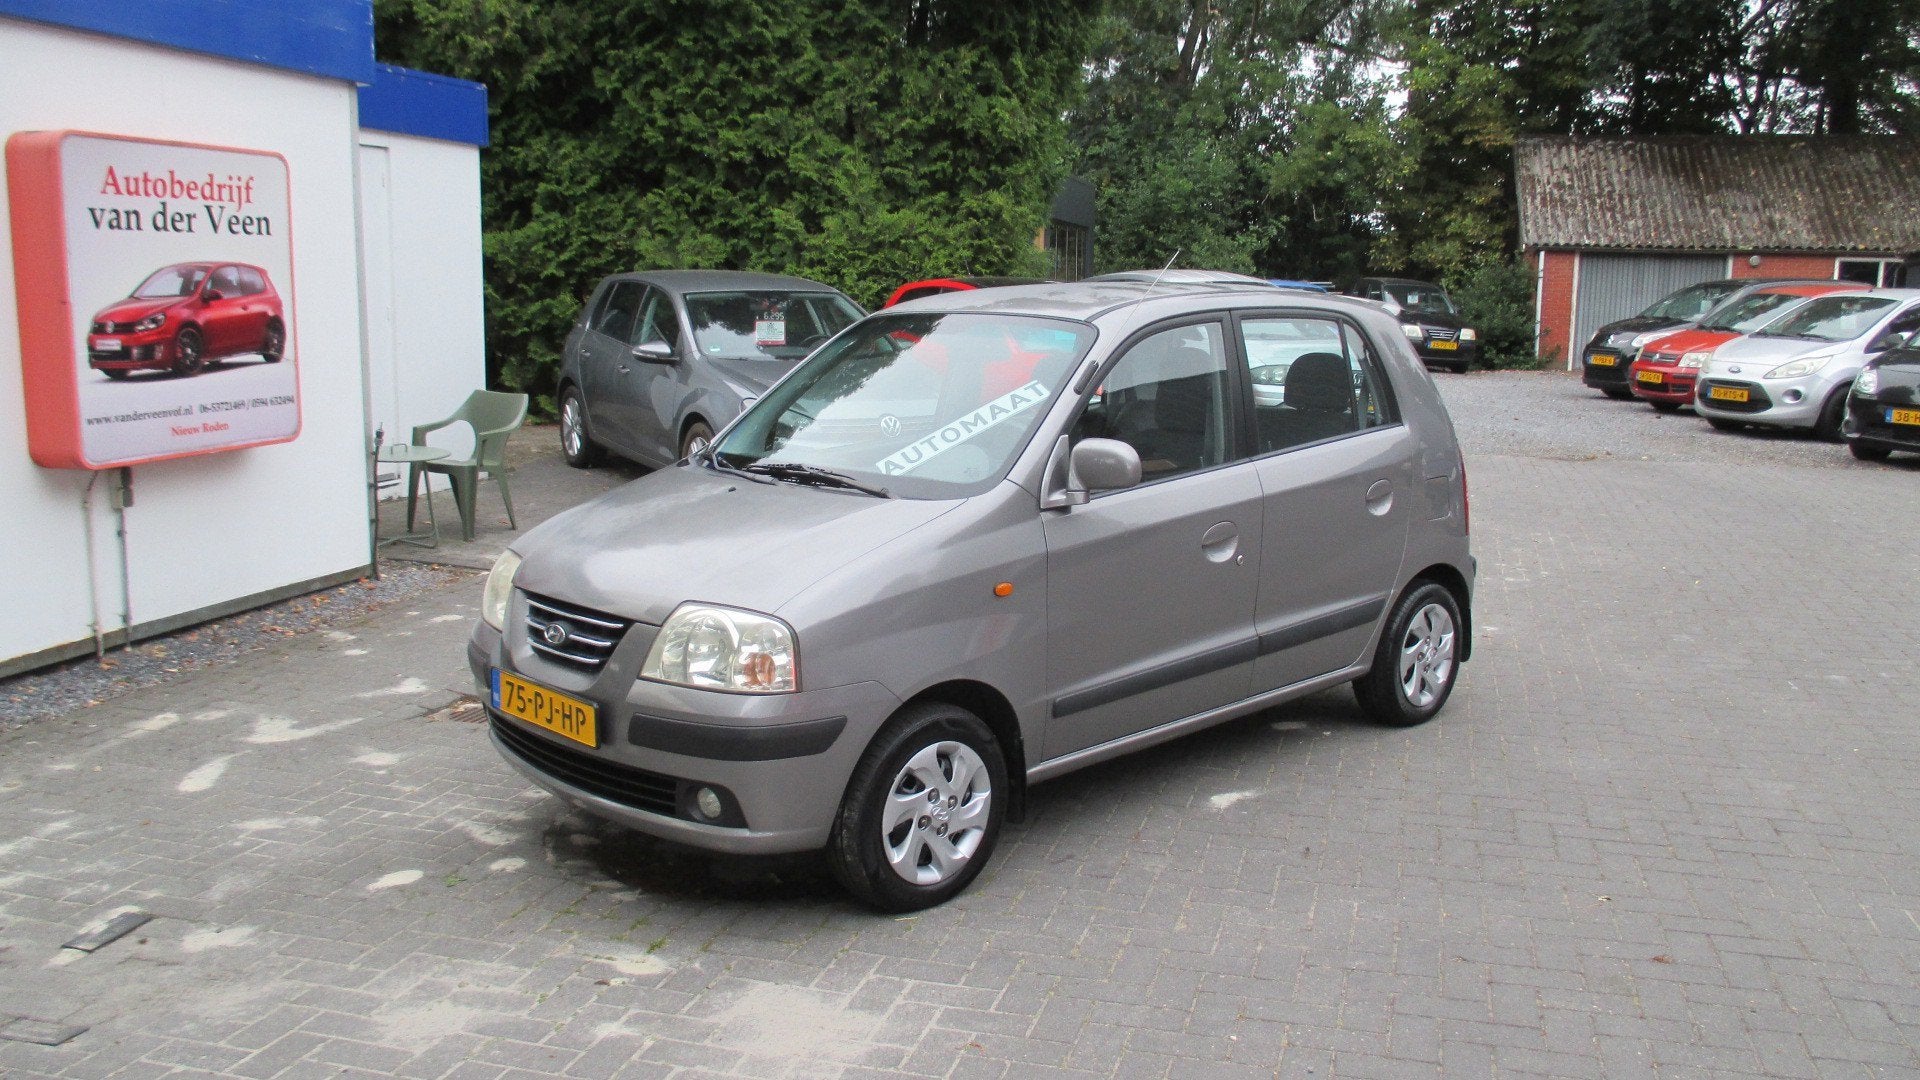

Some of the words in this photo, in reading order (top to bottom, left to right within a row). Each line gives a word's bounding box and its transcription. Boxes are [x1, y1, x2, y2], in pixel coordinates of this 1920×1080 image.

[101, 165, 254, 212] Autobedrijf
[87, 206, 143, 231] van
[152, 201, 197, 232] der
[204, 204, 271, 236] Veen
[171, 425, 200, 436] Nieuw
[203, 421, 229, 432] Roden
[883, 382, 1044, 475] AUTOMAAT
[505, 680, 586, 735] 75-PJ-HP
